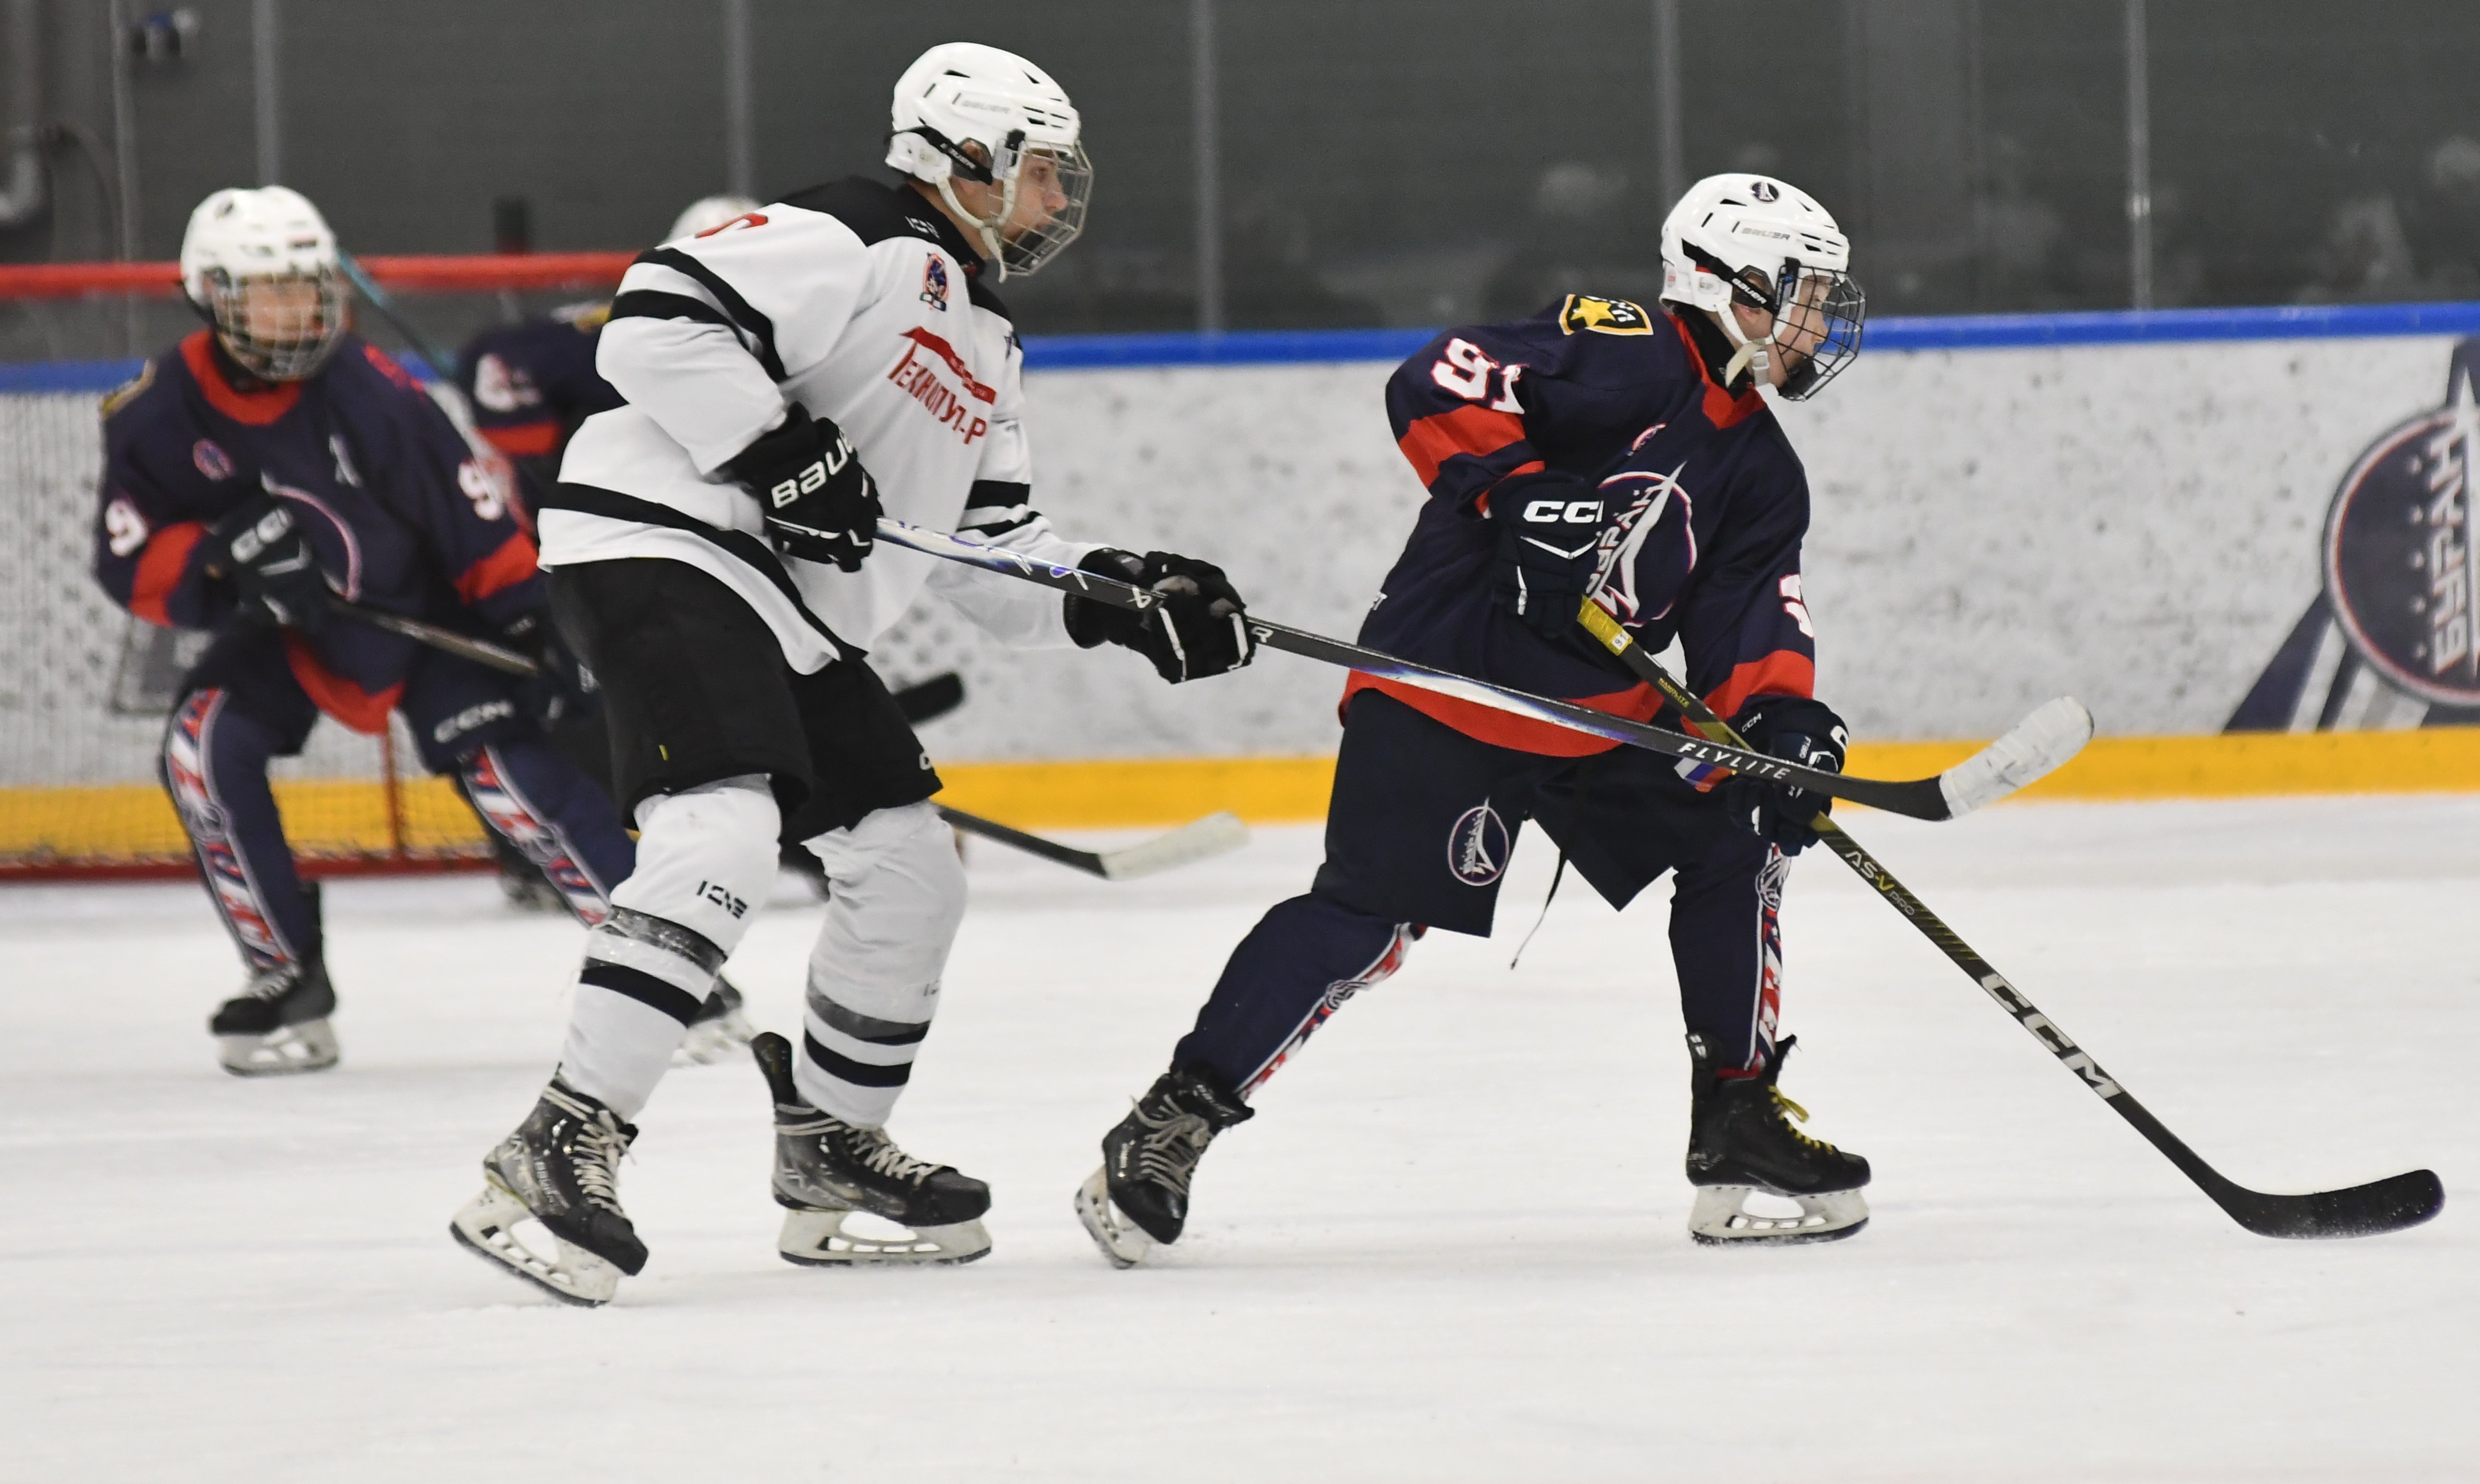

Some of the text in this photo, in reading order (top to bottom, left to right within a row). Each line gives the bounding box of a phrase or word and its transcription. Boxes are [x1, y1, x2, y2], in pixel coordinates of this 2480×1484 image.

[1731, 278, 1767, 304] BAUER
[1430, 337, 1529, 415] 91
[1523, 500, 1604, 523] CC
[1742, 712, 1762, 733] CCM
[1678, 742, 1791, 779] FLYLITE
[1845, 850, 1915, 916] AS-V PRO
[1980, 972, 2126, 1099] CCM
